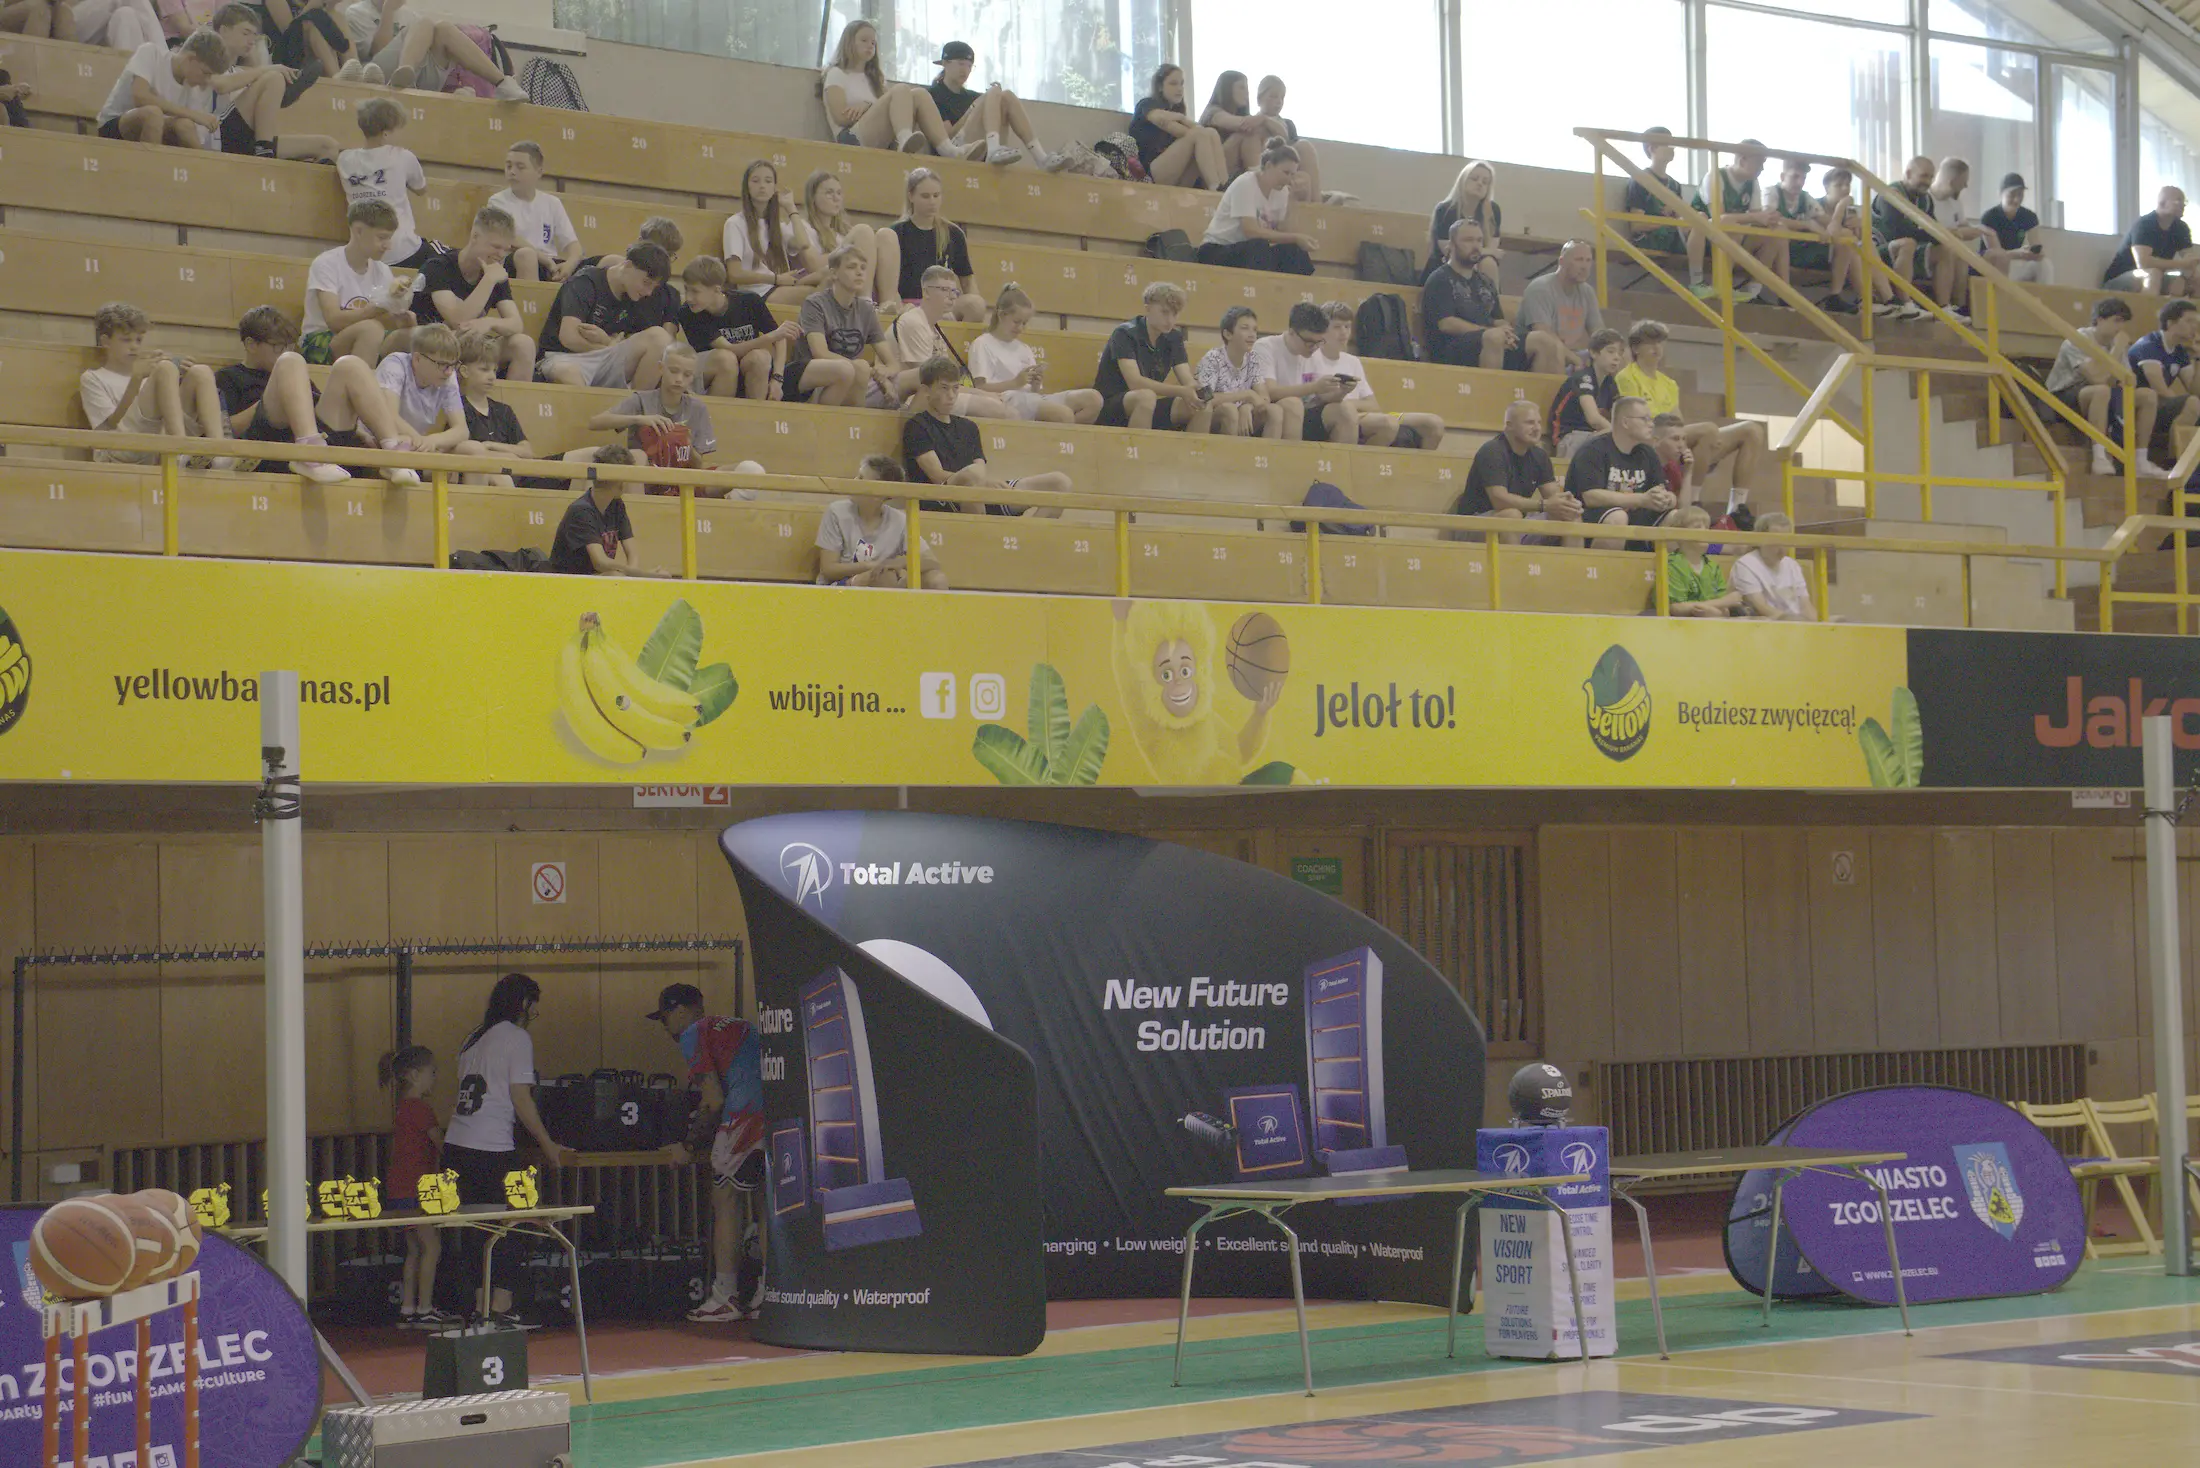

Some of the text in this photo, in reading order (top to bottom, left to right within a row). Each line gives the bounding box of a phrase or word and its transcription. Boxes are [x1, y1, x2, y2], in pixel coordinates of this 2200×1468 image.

[78, 64, 93, 77] 13
[332, 98, 346, 110] 16
[413, 108, 425, 120] 17
[489, 119, 502, 131] 18
[563, 127, 575, 140] 19
[632, 137, 647, 149] 20
[84, 158, 99, 171] 12
[773, 154, 786, 167] 22
[174, 168, 188, 181] 13
[262, 178, 275, 192] 14
[966, 177, 979, 189] 25
[1028, 185, 1041, 196] 26
[1088, 192, 1100, 204] 27
[584, 215, 597, 228] 18
[1317, 219, 1326, 230] 31
[86, 259, 99, 272] 11
[180, 268, 194, 282] 12
[1063, 267, 1076, 279] 25
[270, 277, 284, 290] 13
[1186, 280, 1198, 292] 27
[523, 300, 537, 313] 16
[1514, 388, 1525, 400] 31
[539, 404, 553, 417] 13
[776, 421, 789, 434] 16
[849, 427, 860, 439] 17
[993, 437, 1006, 449] 19
[1060, 442, 1074, 454] 20
[1127, 447, 1138, 459] 21
[1255, 456, 1268, 468] 23
[1318, 460, 1332, 472] 24
[1380, 464, 1392, 476] 25
[50, 484, 64, 499] 11
[253, 496, 268, 511] 13
[348, 501, 363, 516] 14
[529, 511, 544, 524] 16
[698, 520, 711, 533] 18
[779, 524, 792, 537] 19
[931, 532, 943, 545] 21
[1003, 537, 1019, 550] 22
[1075, 540, 1089, 553] 23
[1144, 544, 1159, 557] 24
[1213, 548, 1226, 560] 25
[1279, 551, 1293, 564] 26
[1344, 555, 1356, 567] 27
[1529, 563, 1541, 575] 30
[1587, 567, 1597, 579] 31
[113, 668, 390, 711] yellowbanas.pl
[769, 684, 844, 719] wbijaj
[850, 689, 880, 713] na
[1314, 682, 1457, 737] Jeloł to!
[1678, 701, 1856, 735] Będziesz zwycięzcą!
[840, 861, 994, 885] Total Active
[1103, 976, 1289, 1010] New Future
[1136, 1019, 1266, 1052] Solution
[621, 1101, 639, 1126] 3
[1864, 1165, 1948, 1192] MIASTO
[1557, 1183, 1602, 1196] Total Active
[1500, 1213, 1526, 1234] NEW
[1584, 1212, 1599, 1224] TIME
[1043, 1237, 1424, 1263] arging Low weigt Excellent sund quality Waterproof
[1493, 1239, 1533, 1260] VISION
[1495, 1264, 1533, 1286] SPORT
[1864, 1266, 1938, 1282] WWW.ZRZELEC.EU
[780, 1289, 806, 1304] sound
[806, 1290, 840, 1309] quality
[853, 1288, 931, 1309] Waterproof
[1505, 1304, 1529, 1316] FUTURE
[1500, 1316, 1533, 1329] SOLUTIONS
[1499, 1327, 1538, 1341] FOR PLAYERS
[481, 1356, 504, 1386] 3
[0, 1373, 19, 1400] n
